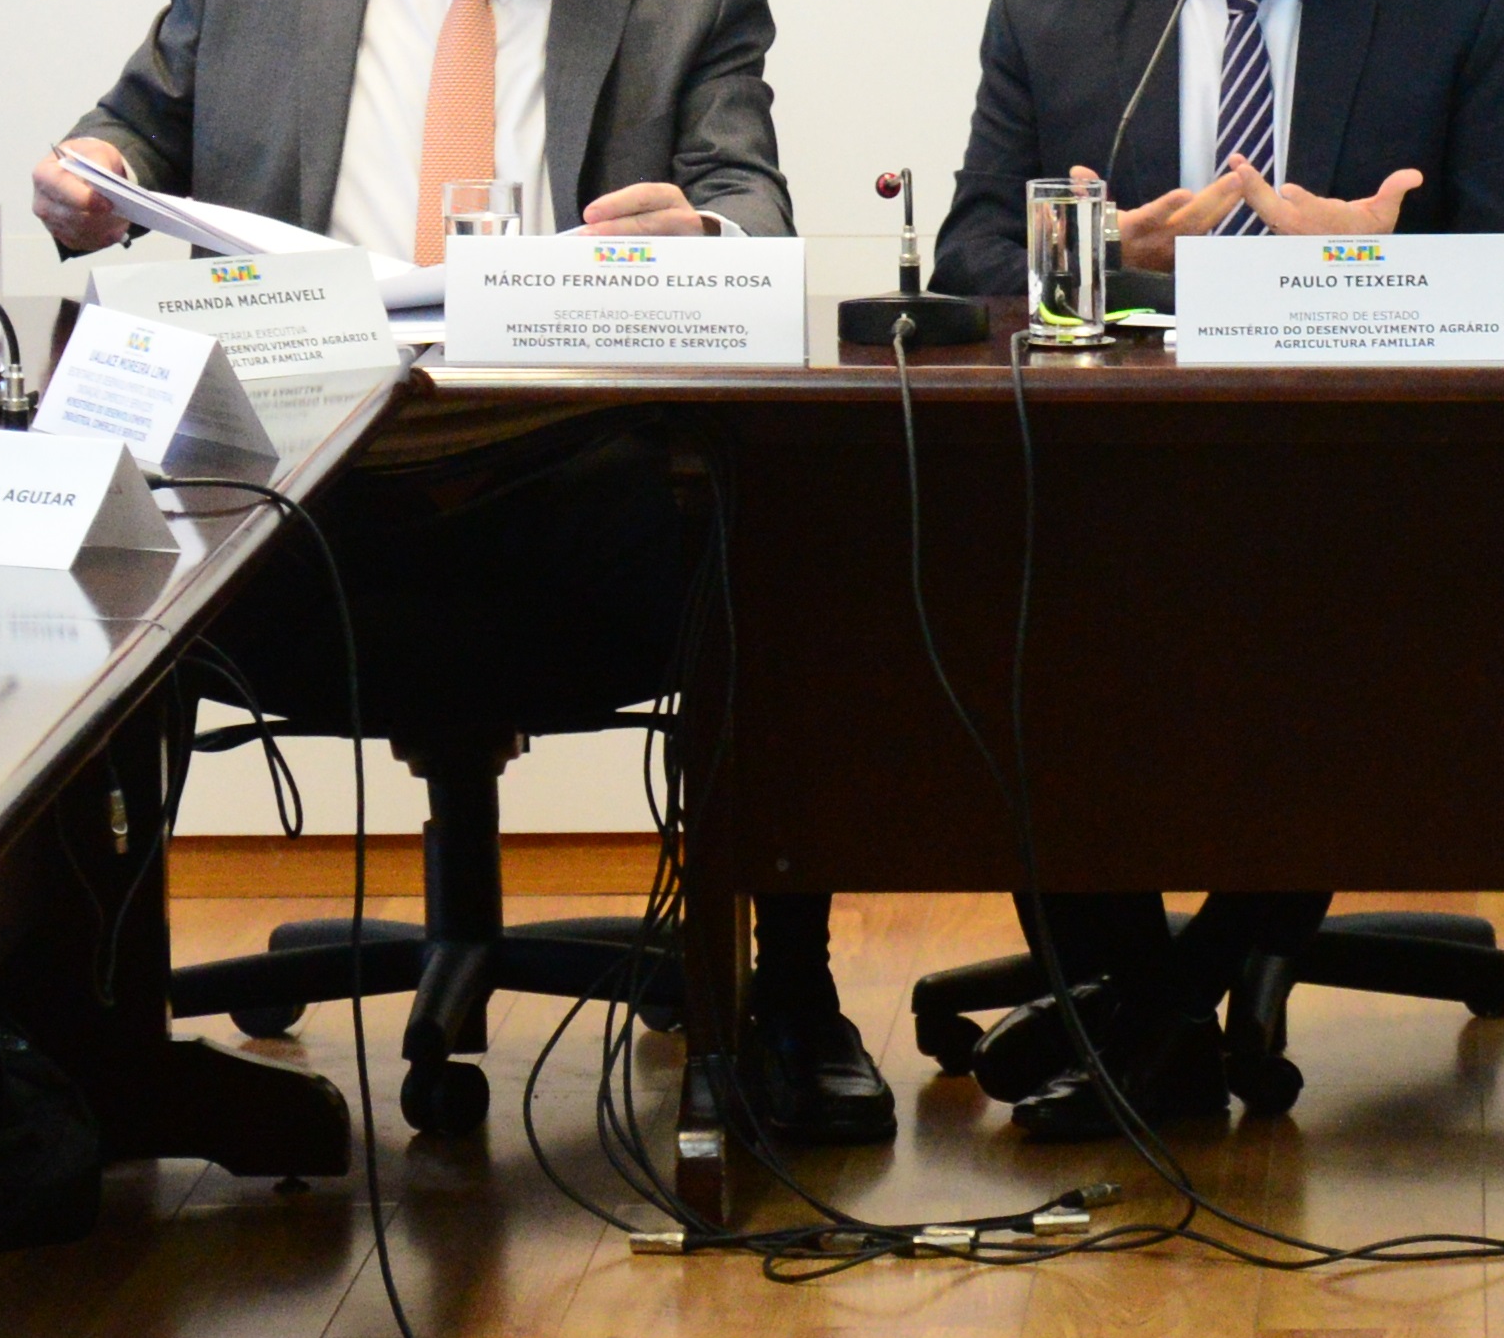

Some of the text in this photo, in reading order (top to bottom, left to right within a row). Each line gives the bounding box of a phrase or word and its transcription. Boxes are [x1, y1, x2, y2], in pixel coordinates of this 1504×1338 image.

[595, 247, 656, 262] BRASIL
[1323, 246, 1385, 261] BRASIL
[484, 271, 772, 288] MÁRCIO FERNANDO ELIAS ROSA
[1280, 275, 1429, 288] PAULO TEIXEIRA
[159, 288, 325, 313] FERNANDA MACHIAVELI
[554, 309, 701, 320] SECRETÁRIO-EXECUTIVO
[1289, 311, 1419, 321] MINISTRO DE ESTADO
[256, 326, 308, 339] EXECUTIVA
[506, 322, 748, 335] MINISTÉRIO DO DESENVOLVIMENTO,
[1198, 324, 1278, 336] MINISTÉRIO
[1283, 326, 1301, 335] DO
[1306, 324, 1434, 335] DESENVOLVIMENTO
[1439, 322, 1499, 333] AGRÁRIO
[322, 332, 377, 345] AGRÁRIO E
[512, 335, 747, 349] INDÚSTRIA, COMÉRCIO E SERVIÇOS
[1275, 338, 1435, 349] AGRICULTURA FAMILIAR
[272, 351, 323, 364] FAMILIAR
[3, 489, 77, 507] AGUIAR
